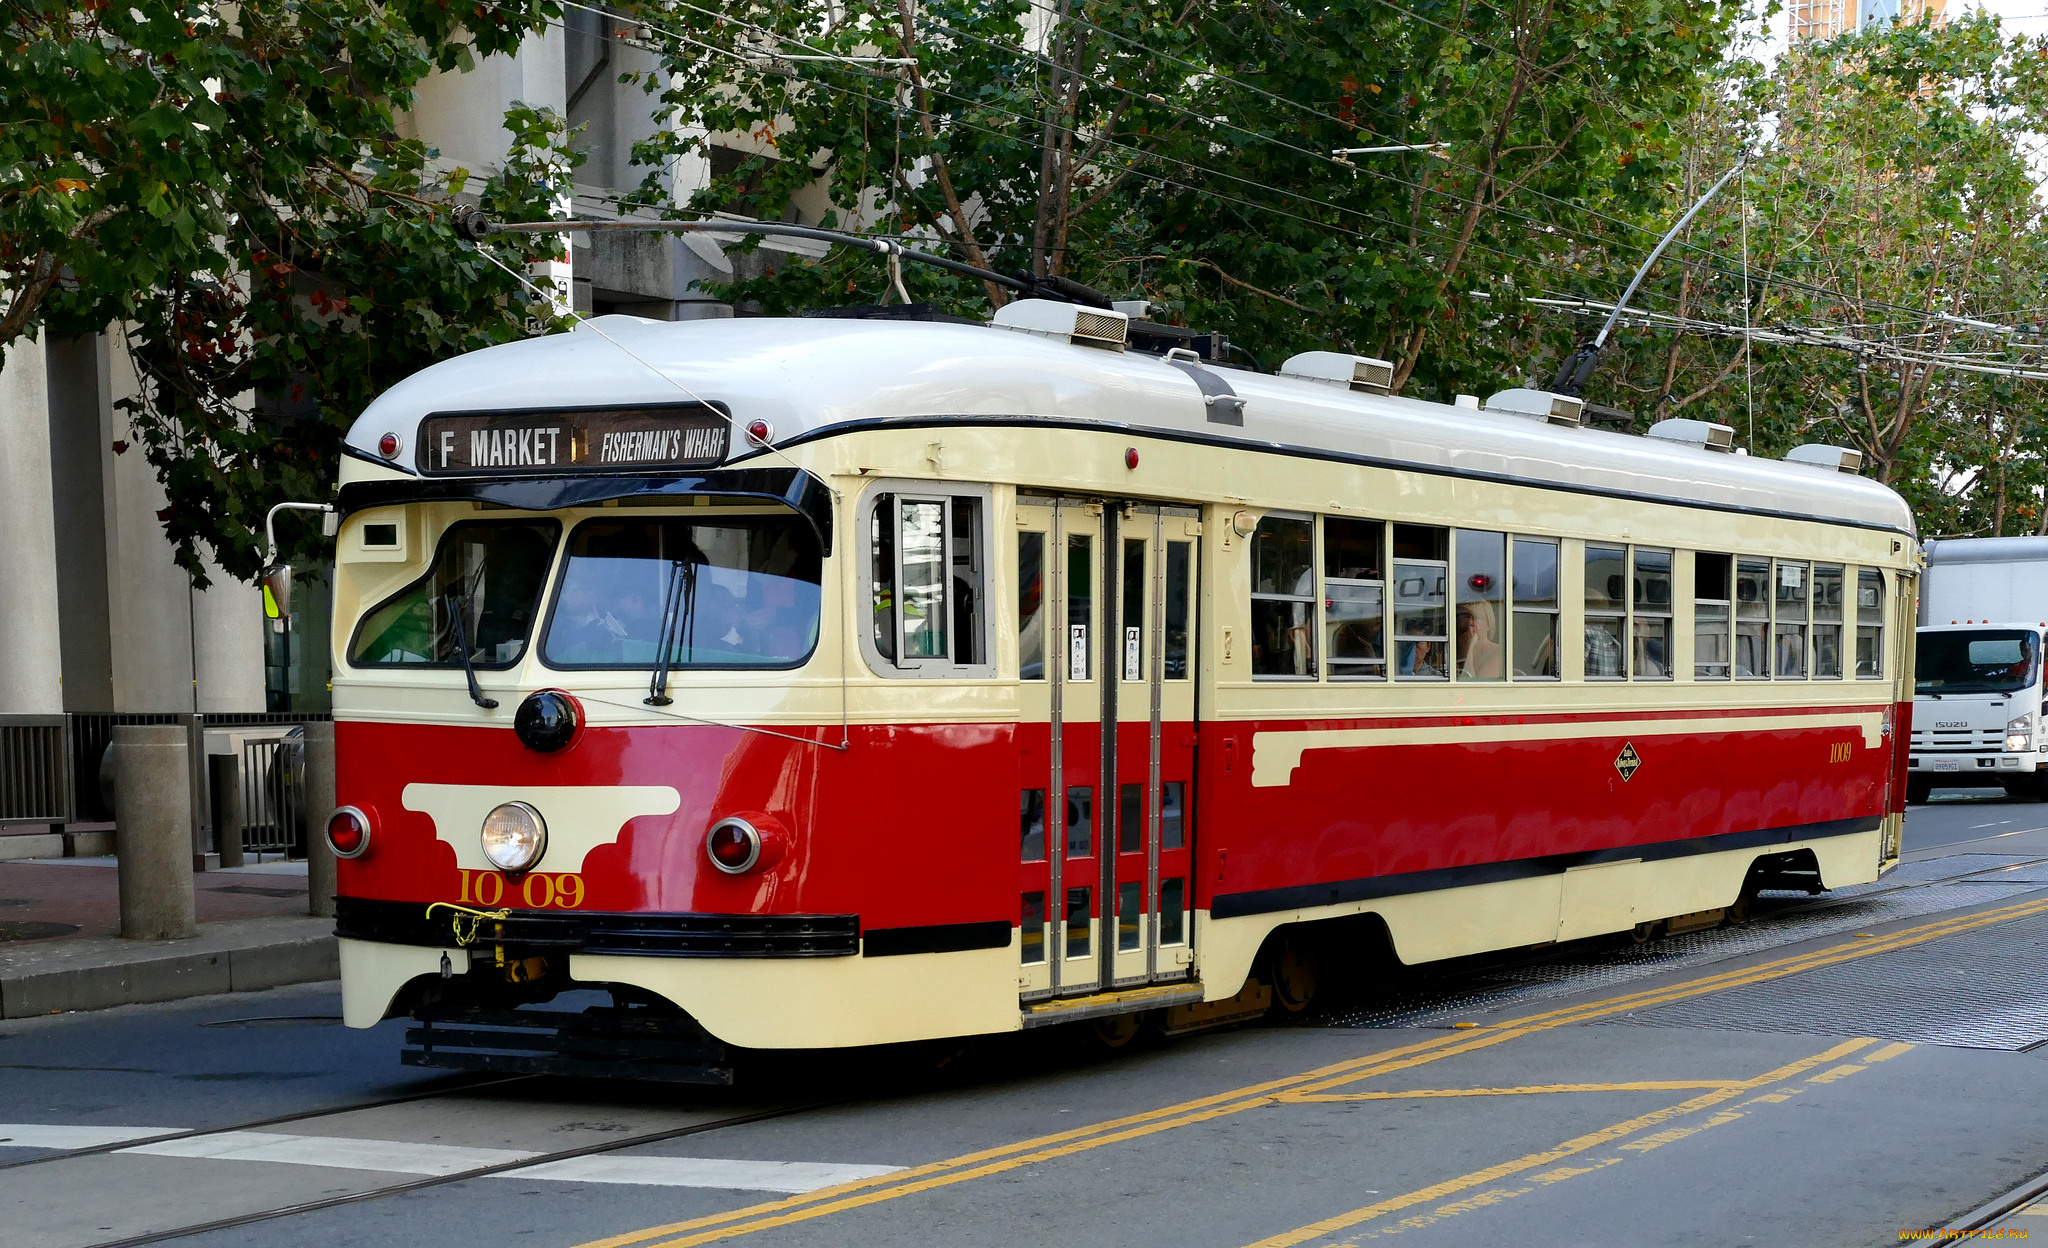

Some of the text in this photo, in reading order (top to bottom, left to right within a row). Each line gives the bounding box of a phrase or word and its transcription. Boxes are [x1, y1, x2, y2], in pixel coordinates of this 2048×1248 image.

[440, 427, 560, 468] F MARKET
[600, 427, 726, 463] FISHERMAN'S WHARF
[1829, 741, 1852, 764] 1009
